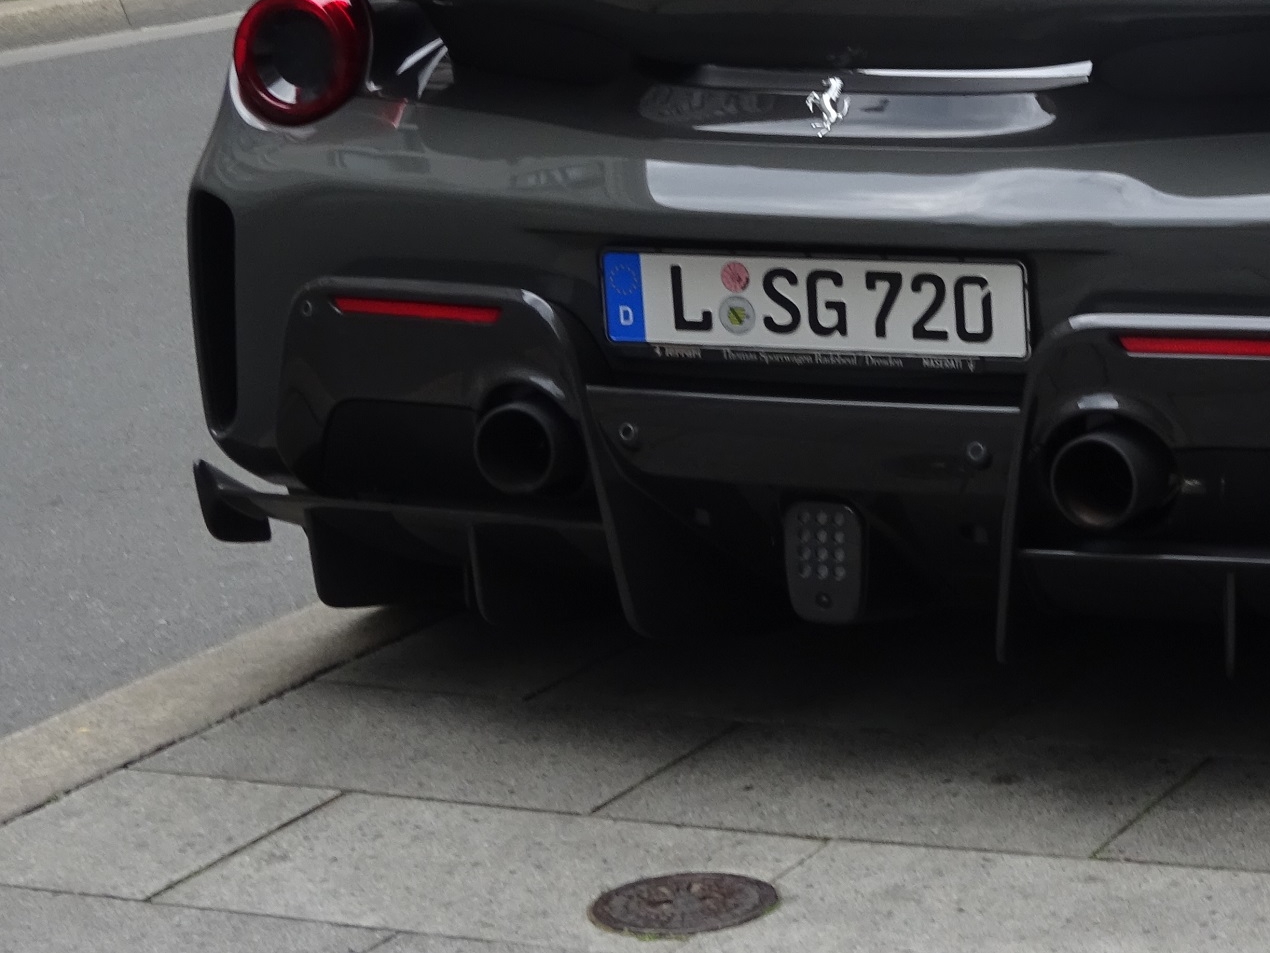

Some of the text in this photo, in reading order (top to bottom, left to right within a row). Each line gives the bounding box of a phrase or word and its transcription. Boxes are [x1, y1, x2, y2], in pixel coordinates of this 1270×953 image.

[618, 304, 635, 327] D
[670, 263, 994, 344] L SG 720
